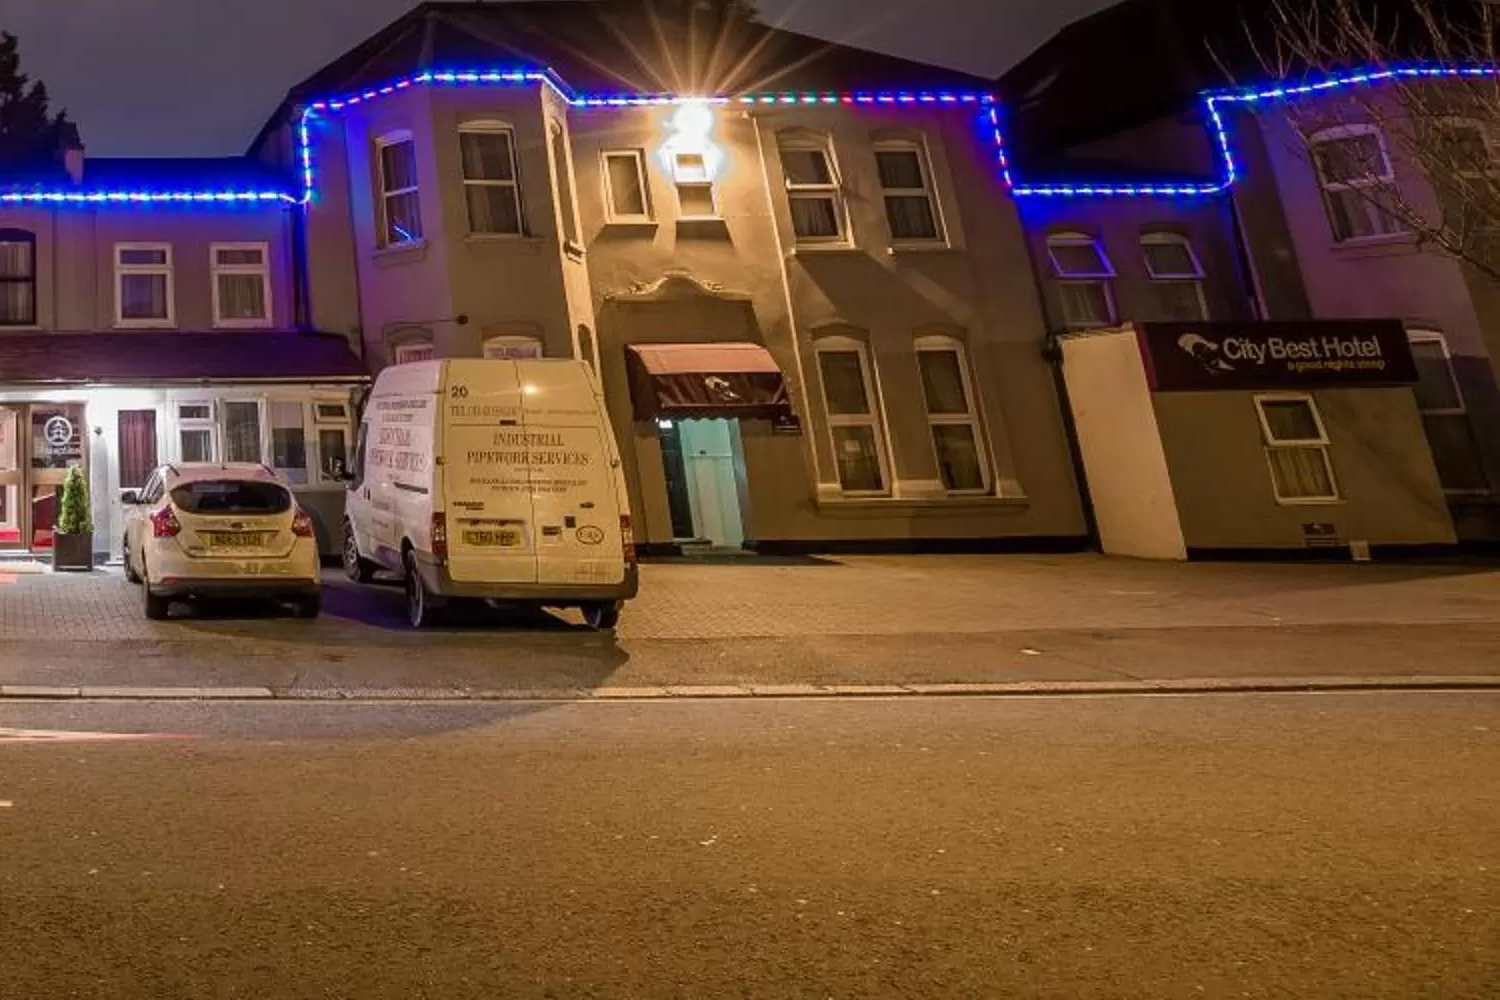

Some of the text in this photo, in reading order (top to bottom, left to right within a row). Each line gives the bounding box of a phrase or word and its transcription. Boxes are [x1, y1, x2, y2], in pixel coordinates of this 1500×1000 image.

[1222, 335, 1382, 365] City Best Hotel
[451, 385, 469, 398] 20
[493, 431, 565, 447] INDUSTRIAL
[467, 451, 589, 466] PIPEWORK SERVICES
